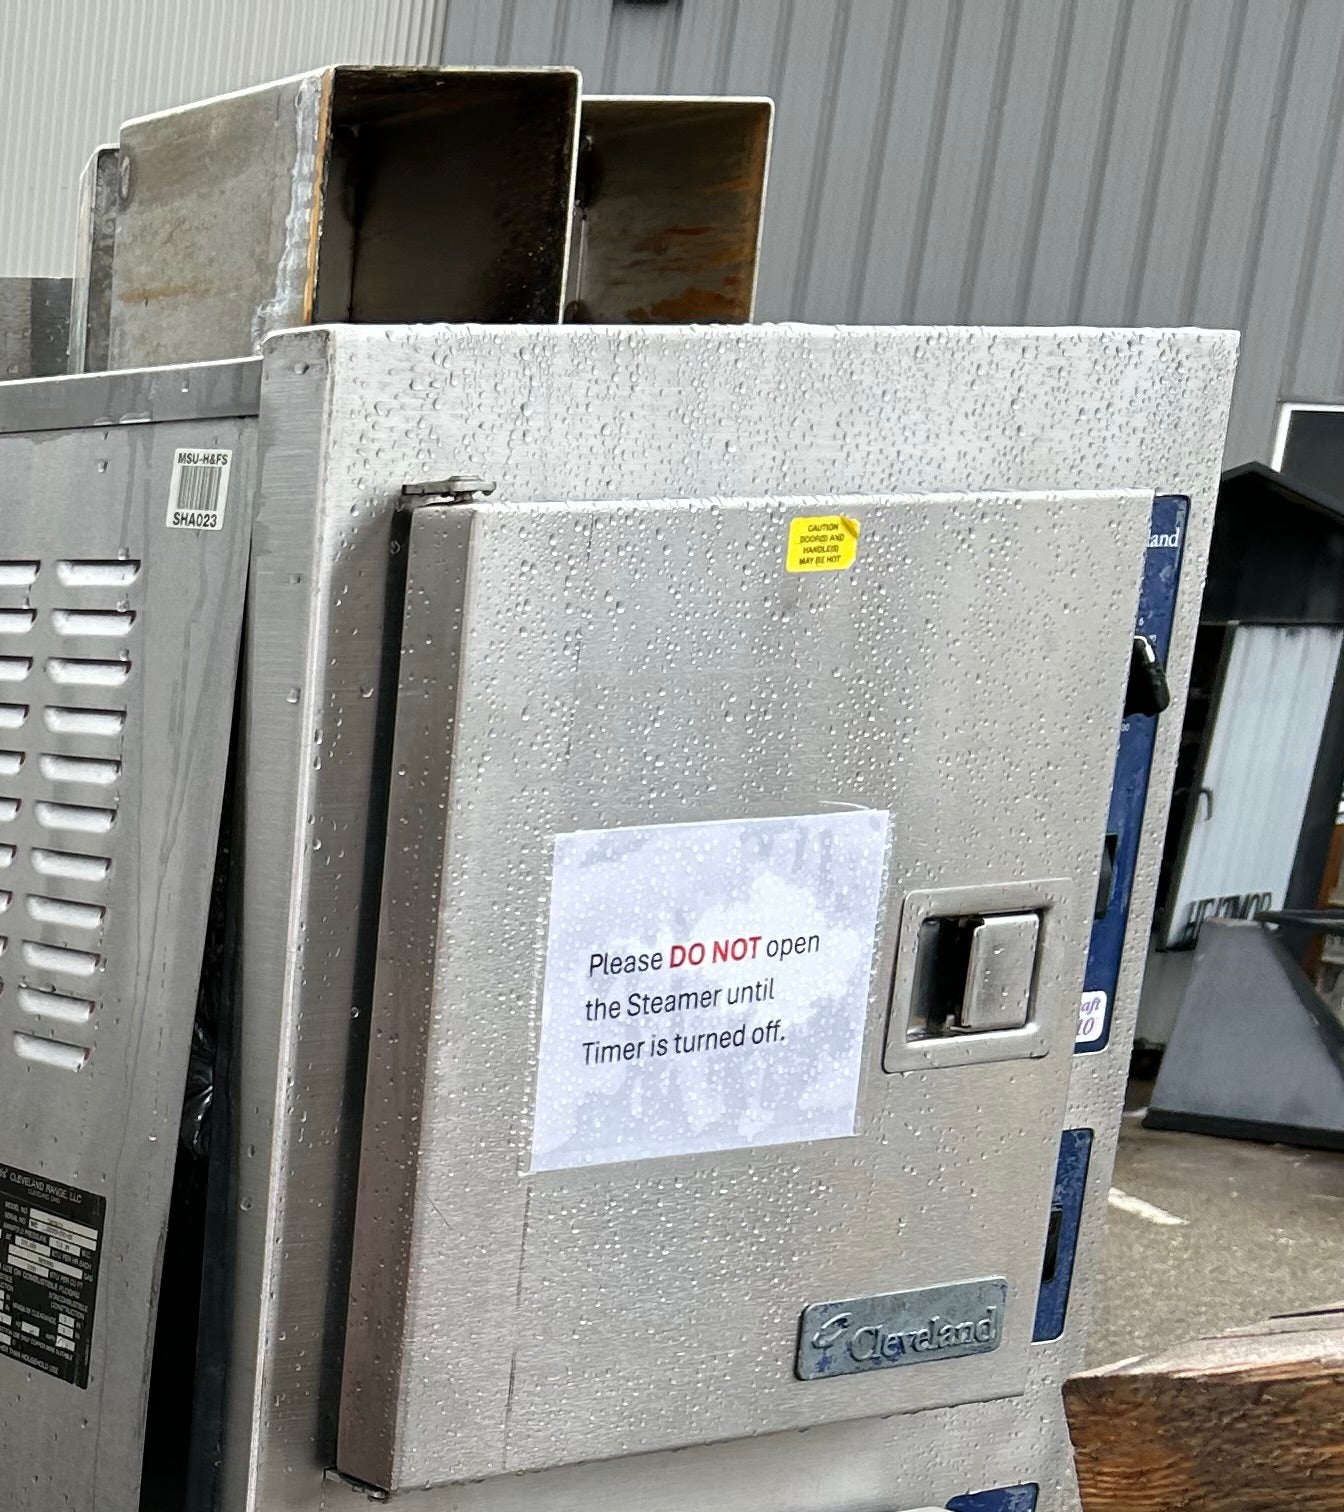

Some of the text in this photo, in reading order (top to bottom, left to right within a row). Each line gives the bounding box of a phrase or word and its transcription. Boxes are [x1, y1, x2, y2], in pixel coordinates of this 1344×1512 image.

[178, 453, 228, 465] MSU-H&FS
[172, 512, 218, 528] SHA023
[808, 523, 838, 532] CAUTION
[589, 934, 821, 978] Please DO NOT open
[585, 977, 775, 1022] the Steamer until
[582, 1019, 786, 1066] Timer is turned off.
[850, 1306, 998, 1363] Cleveland
